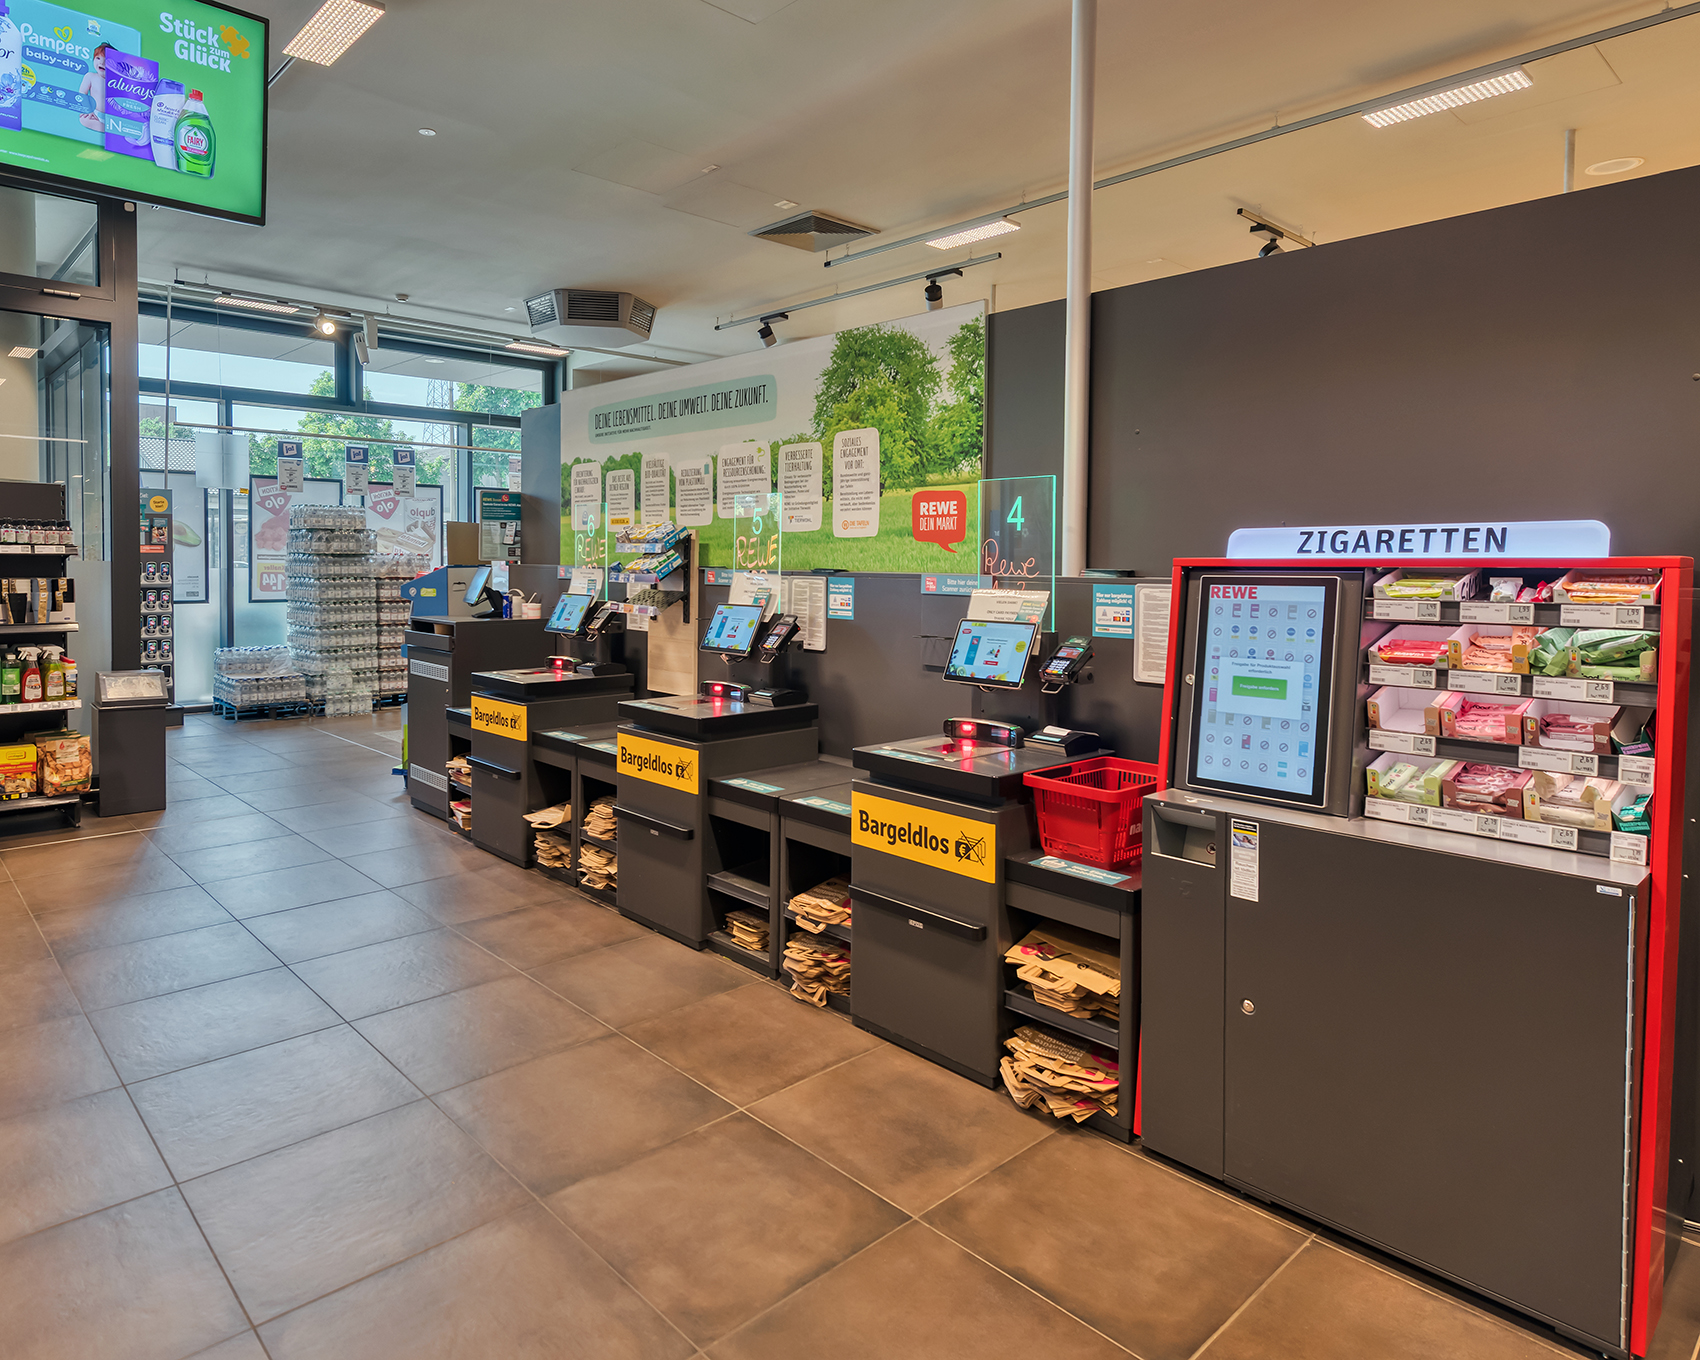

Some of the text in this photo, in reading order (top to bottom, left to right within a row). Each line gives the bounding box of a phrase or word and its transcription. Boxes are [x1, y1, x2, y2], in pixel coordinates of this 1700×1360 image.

[160, 12, 219, 48] Stück
[20, 23, 90, 59] Pampers
[26, 48, 82, 71] baby-dry
[174, 39, 231, 73] Glück
[210, 48, 230, 59] zum
[108, 78, 155, 100] always
[187, 135, 204, 146] FAIRY
[594, 384, 768, 430] DEINE LEBENSMITTEL. DEINE UMWELT. DEINE ZUKUNFT.
[284, 445, 294, 454] ja!
[842, 437, 861, 448] SOZIALES
[352, 449, 362, 458] ja!
[400, 453, 408, 461] ja!
[785, 449, 813, 460] VERBESSERTE
[840, 447, 868, 458] ENGAGEMENT
[785, 461, 812, 472] TIERHALTUNG
[844, 461, 853, 469] VOR
[920, 501, 958, 515] REWE
[1007, 496, 1024, 531] 4
[588, 514, 594, 537] 6
[752, 508, 762, 534] 5
[920, 516, 957, 531] DEIN MARKT
[1297, 527, 1508, 554] ZIGARETTEN
[1211, 586, 1257, 599] REWE
[474, 707, 509, 728] Bargeldlos
[621, 746, 672, 772] Bargeldlos
[859, 809, 949, 854] Bargeldlos
